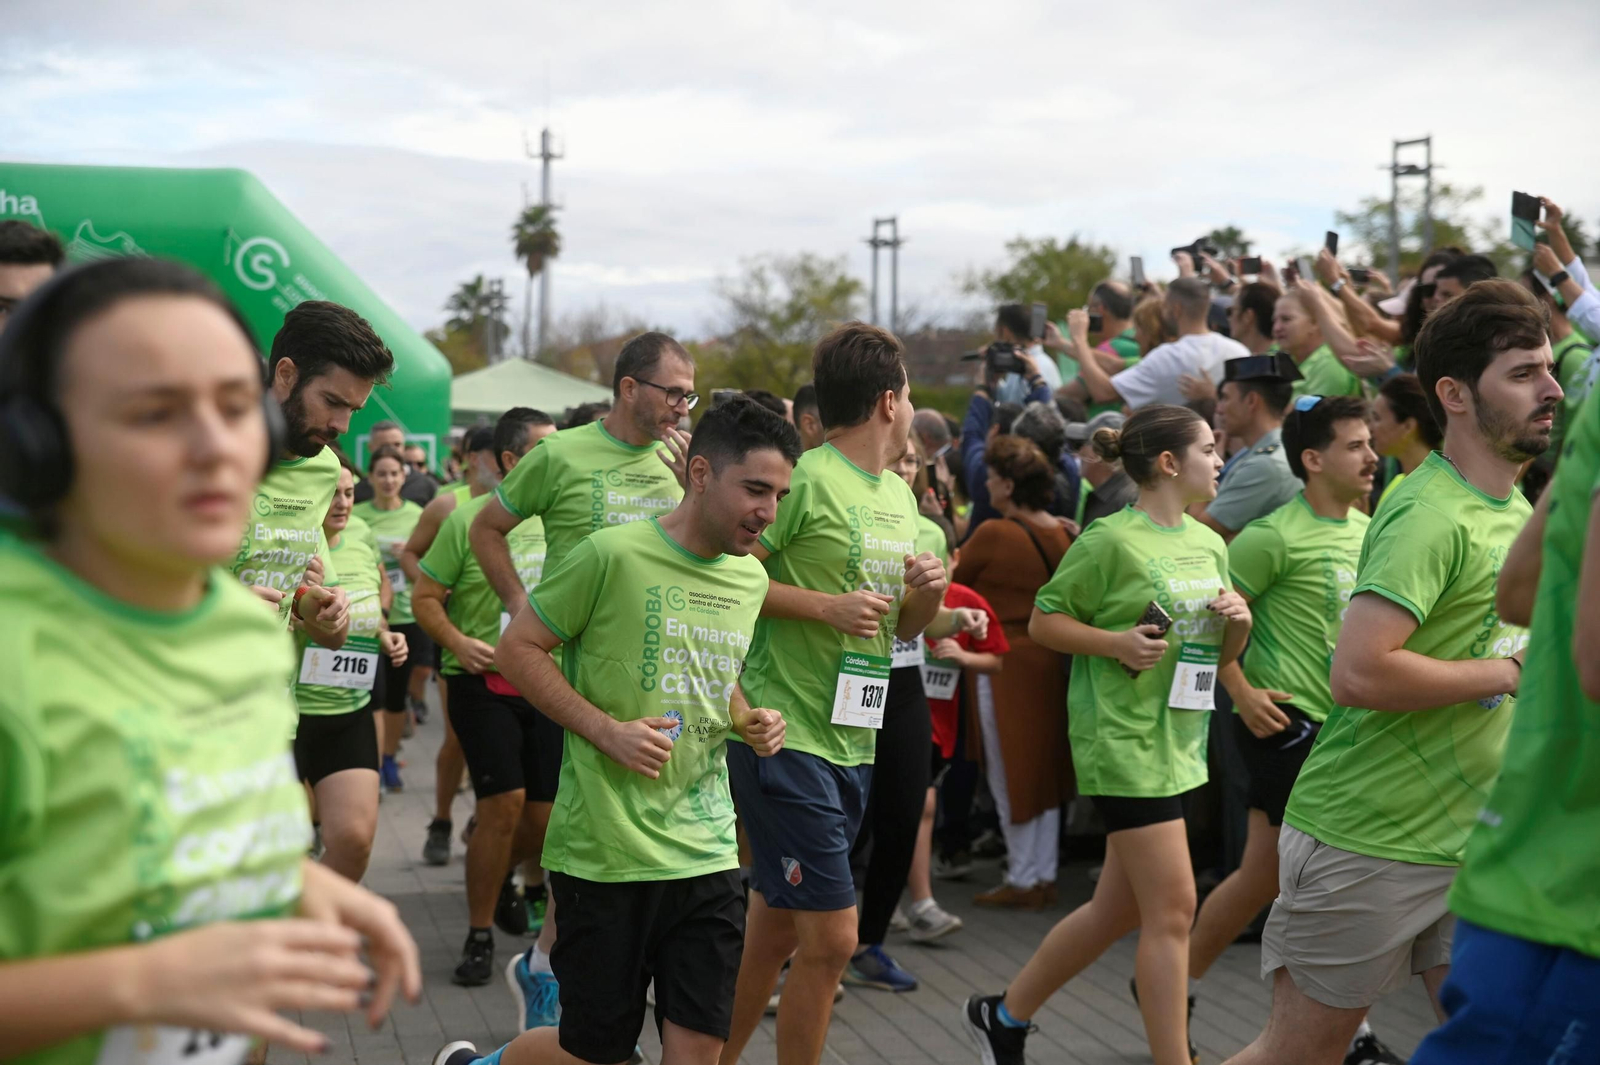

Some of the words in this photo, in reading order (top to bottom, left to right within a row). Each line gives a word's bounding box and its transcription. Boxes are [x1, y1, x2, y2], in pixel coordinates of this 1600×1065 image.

[607, 491, 627, 505] En
[254, 524, 272, 540] En
[864, 532, 879, 549] En
[840, 505, 862, 593] CÓRDOBA
[1168, 578, 1189, 593] En
[689, 591, 717, 600] asociación
[718, 596, 741, 605] española
[689, 598, 706, 606] contra
[713, 602, 731, 610] cáncer
[637, 585, 662, 692] CÓRDOBA
[666, 617, 688, 638] En
[692, 625, 750, 650] marcha
[332, 656, 369, 675] 2116
[663, 647, 730, 672] contra
[845, 656, 869, 667] Córdoba
[661, 667, 735, 702] cánce
[861, 684, 884, 708] 1378
